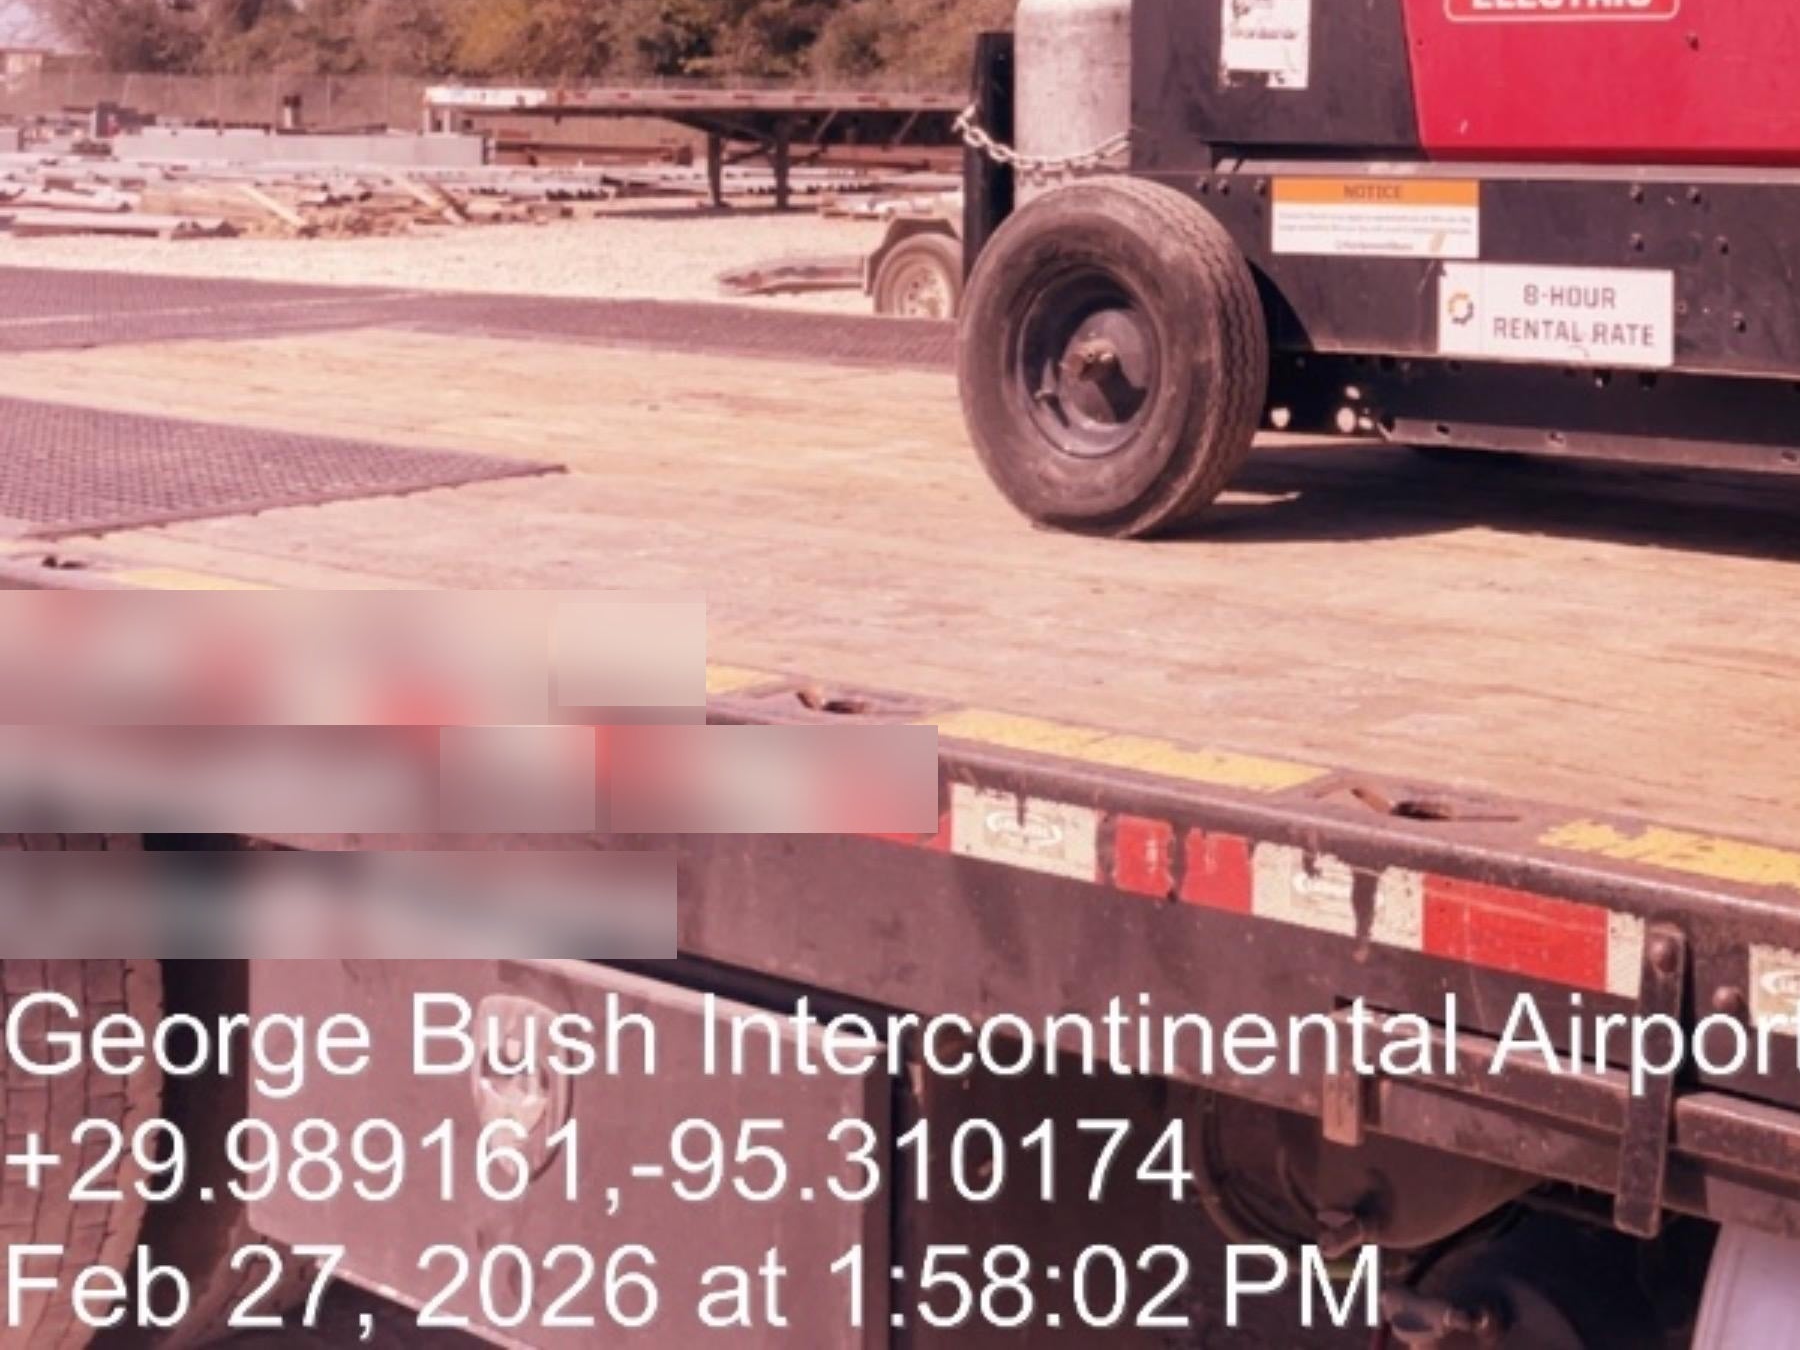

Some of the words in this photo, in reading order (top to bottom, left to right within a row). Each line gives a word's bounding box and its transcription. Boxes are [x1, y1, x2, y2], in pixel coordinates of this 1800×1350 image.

[1343, 184, 1402, 200] NOTICE
[1521, 283, 1617, 311] 8-HOUR
[1492, 316, 1585, 344] RENTAL
[1591, 322, 1656, 348] RATE
